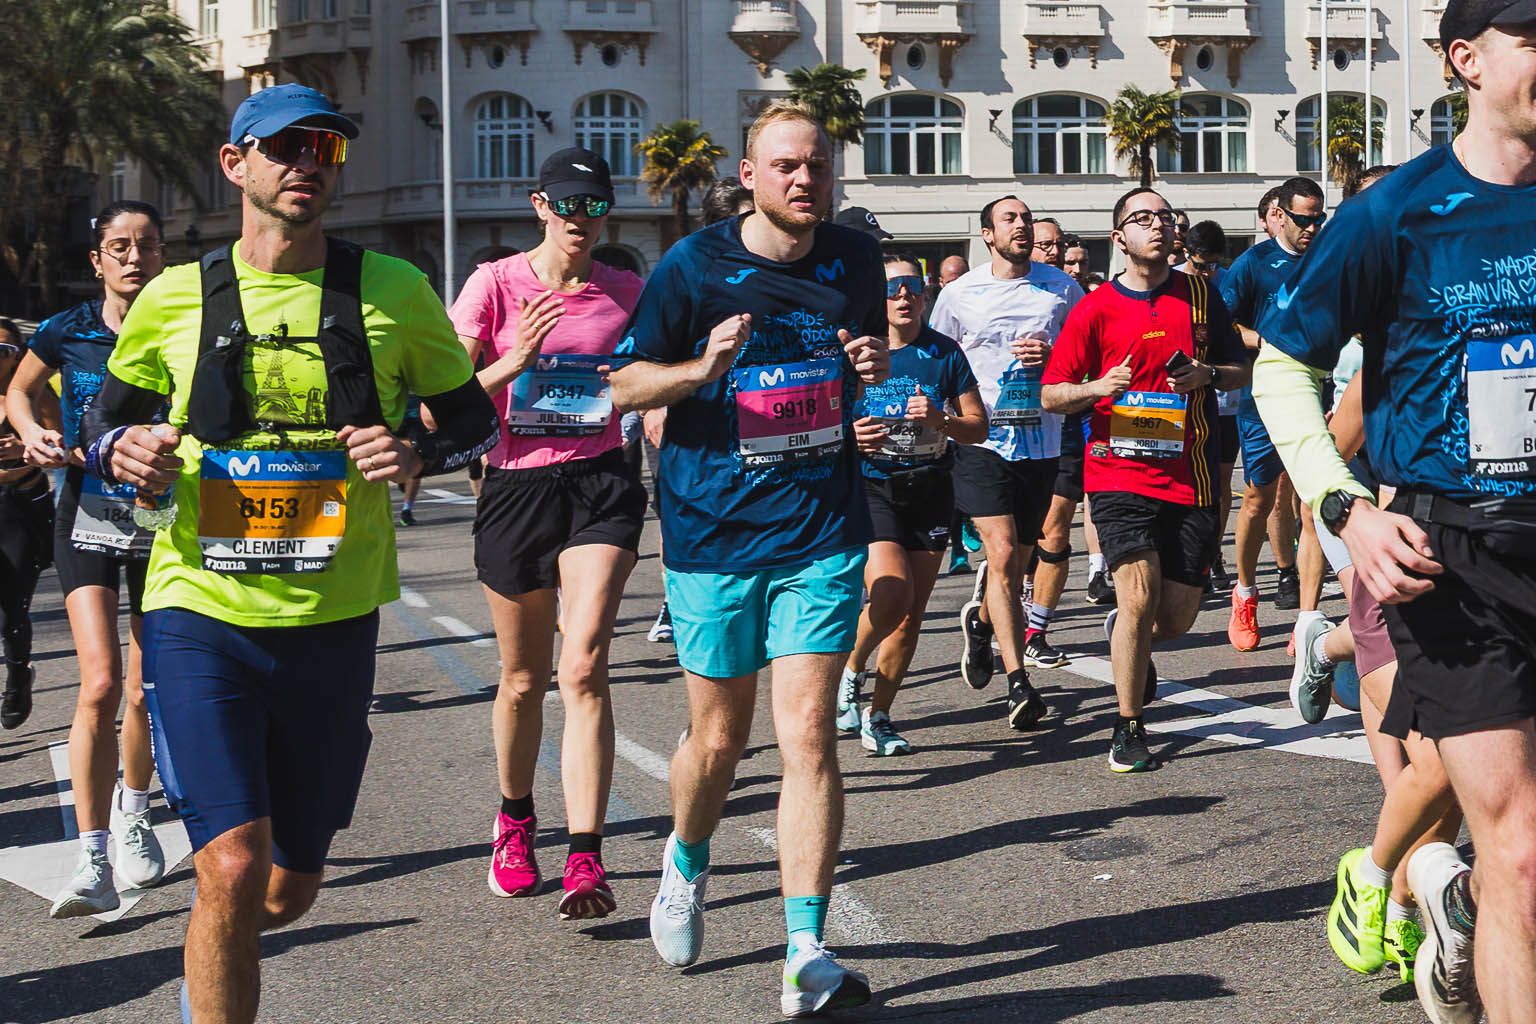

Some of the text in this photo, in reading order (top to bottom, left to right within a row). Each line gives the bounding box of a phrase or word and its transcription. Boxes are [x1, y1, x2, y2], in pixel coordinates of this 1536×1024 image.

[1443, 280, 1490, 307] GRAN
[1142, 330, 1166, 340] adidas
[789, 367, 829, 381] movistar
[537, 383, 585, 400] 16347
[1006, 389, 1032, 401] 15394
[1145, 396, 1175, 405] movistar
[772, 397, 818, 421] 9918
[535, 414, 585, 424] JULIETTE
[1131, 416, 1162, 430] 4967
[787, 433, 811, 448] EIM
[1134, 439, 1159, 449] JORDI
[752, 453, 785, 465] Joma
[267, 461, 322, 473] movistar
[1486, 459, 1530, 475] Joma
[240, 497, 299, 519] 6153
[85, 532, 113, 545] VANDA
[232, 539, 307, 556] CLEMENT
[208, 558, 248, 571] Joma
